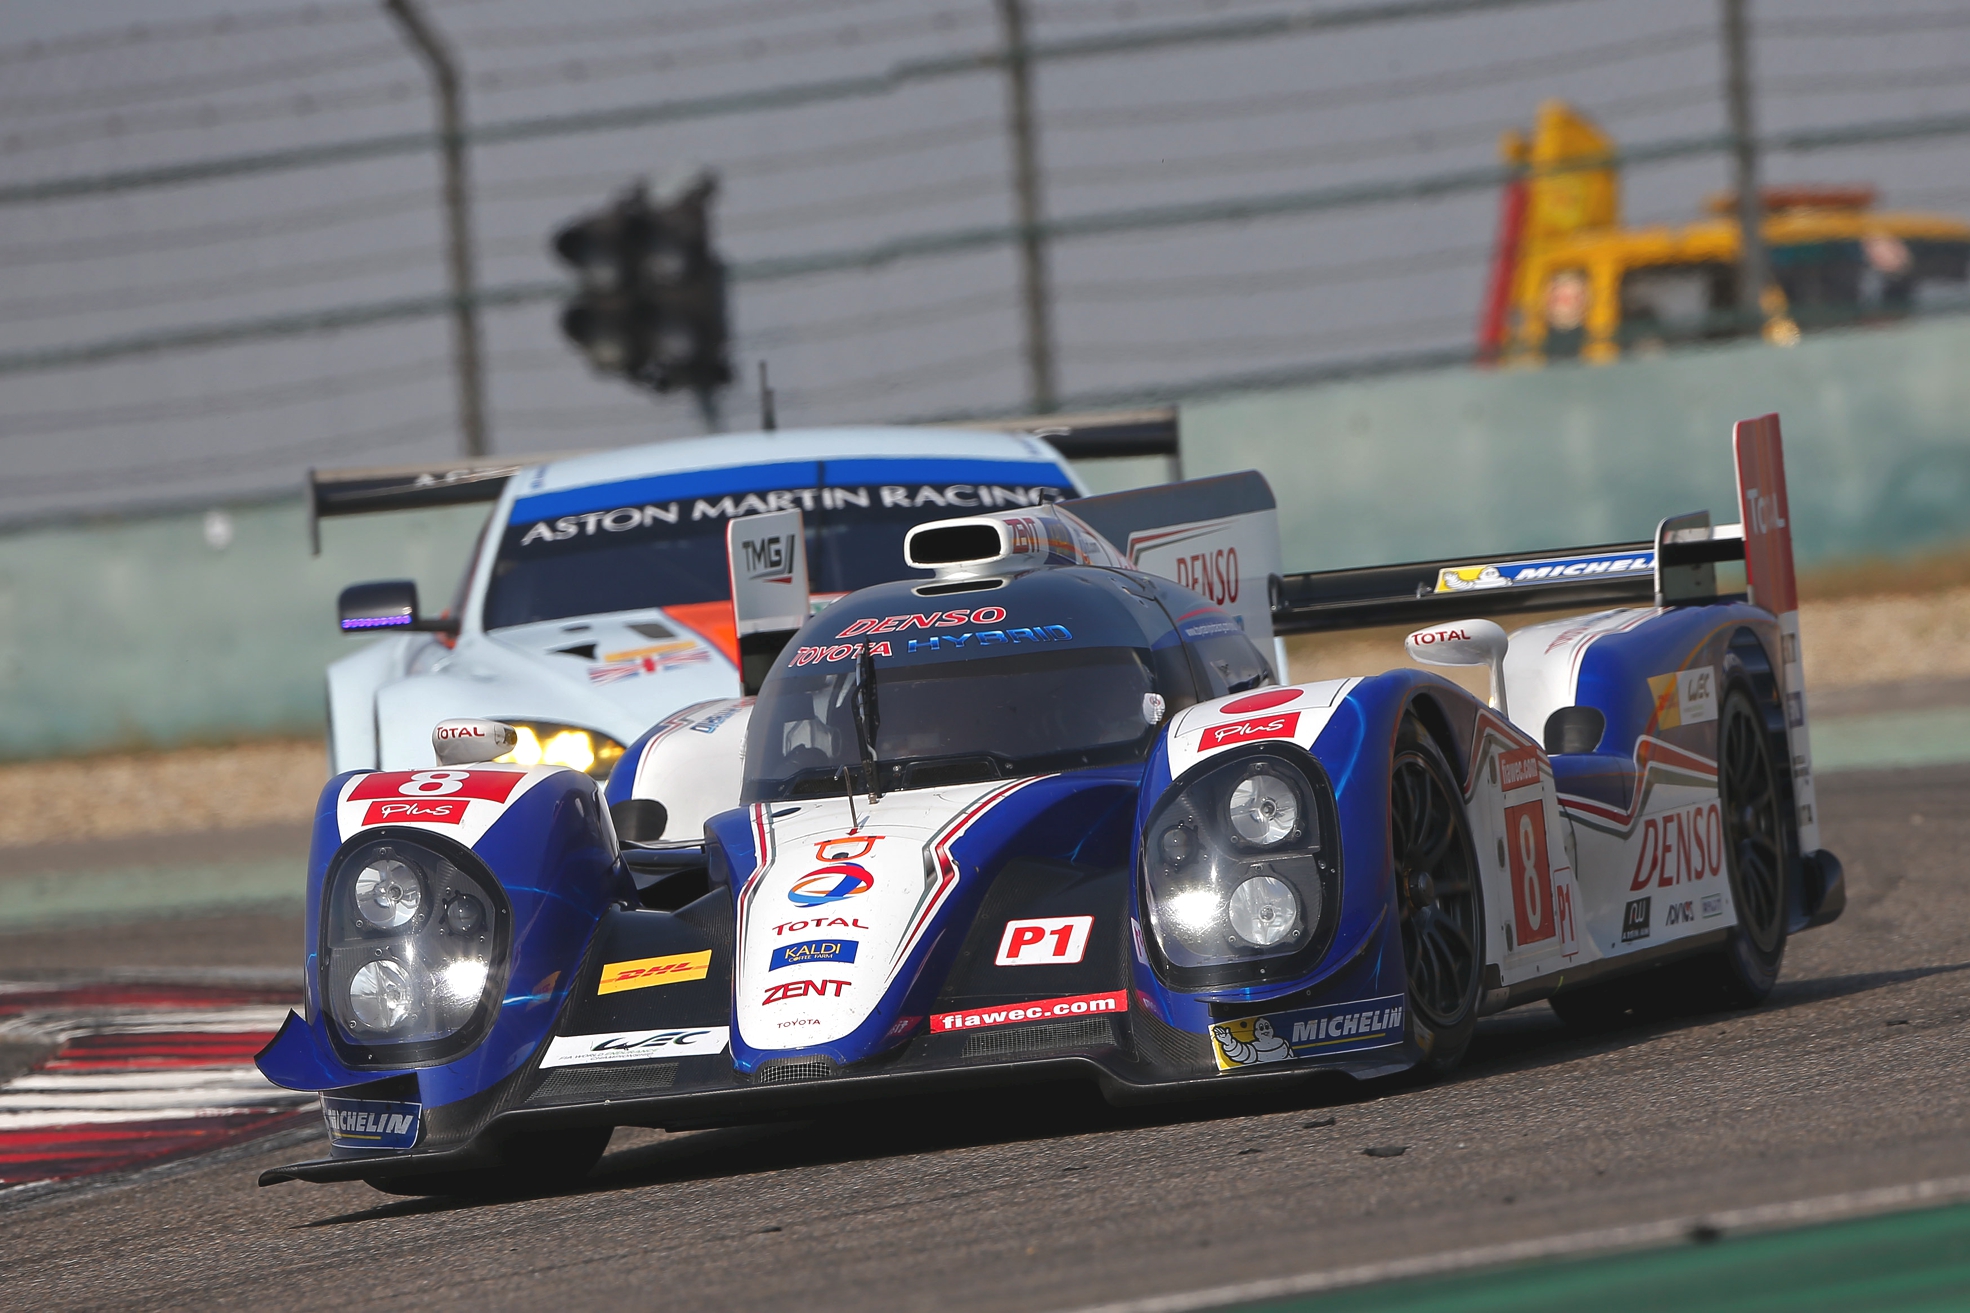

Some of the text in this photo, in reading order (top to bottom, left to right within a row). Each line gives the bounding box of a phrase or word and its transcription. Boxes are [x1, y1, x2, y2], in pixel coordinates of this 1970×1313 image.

[521, 484, 1065, 546] ASTON MARTIN RACING
[1176, 547, 1239, 606] DENSO
[835, 606, 1006, 639] DENSO
[788, 624, 1073, 668] TOYOTA HYBRID
[1412, 629, 1471, 647] TOTAL
[437, 726, 486, 741] TOTAL
[1214, 719, 1285, 743] Plus
[398, 770, 471, 797] 8
[381, 803, 453, 819] Plus
[1629, 803, 1722, 892] DENSO
[1519, 813, 1542, 931] 8
[772, 917, 869, 936] TOTAL
[1556, 883, 1575, 944] P1
[784, 943, 841, 959] KALDI
[1006, 925, 1074, 959] P1
[615, 961, 693, 982] DHL
[761, 979, 852, 1006] ZENT
[777, 1018, 821, 1029] TOYOTA
[942, 997, 1116, 1029] fiawec.com
[1291, 1006, 1403, 1042] MICHELIN
[592, 1031, 711, 1051] WEC
[327, 1109, 414, 1135] MICHELIN
